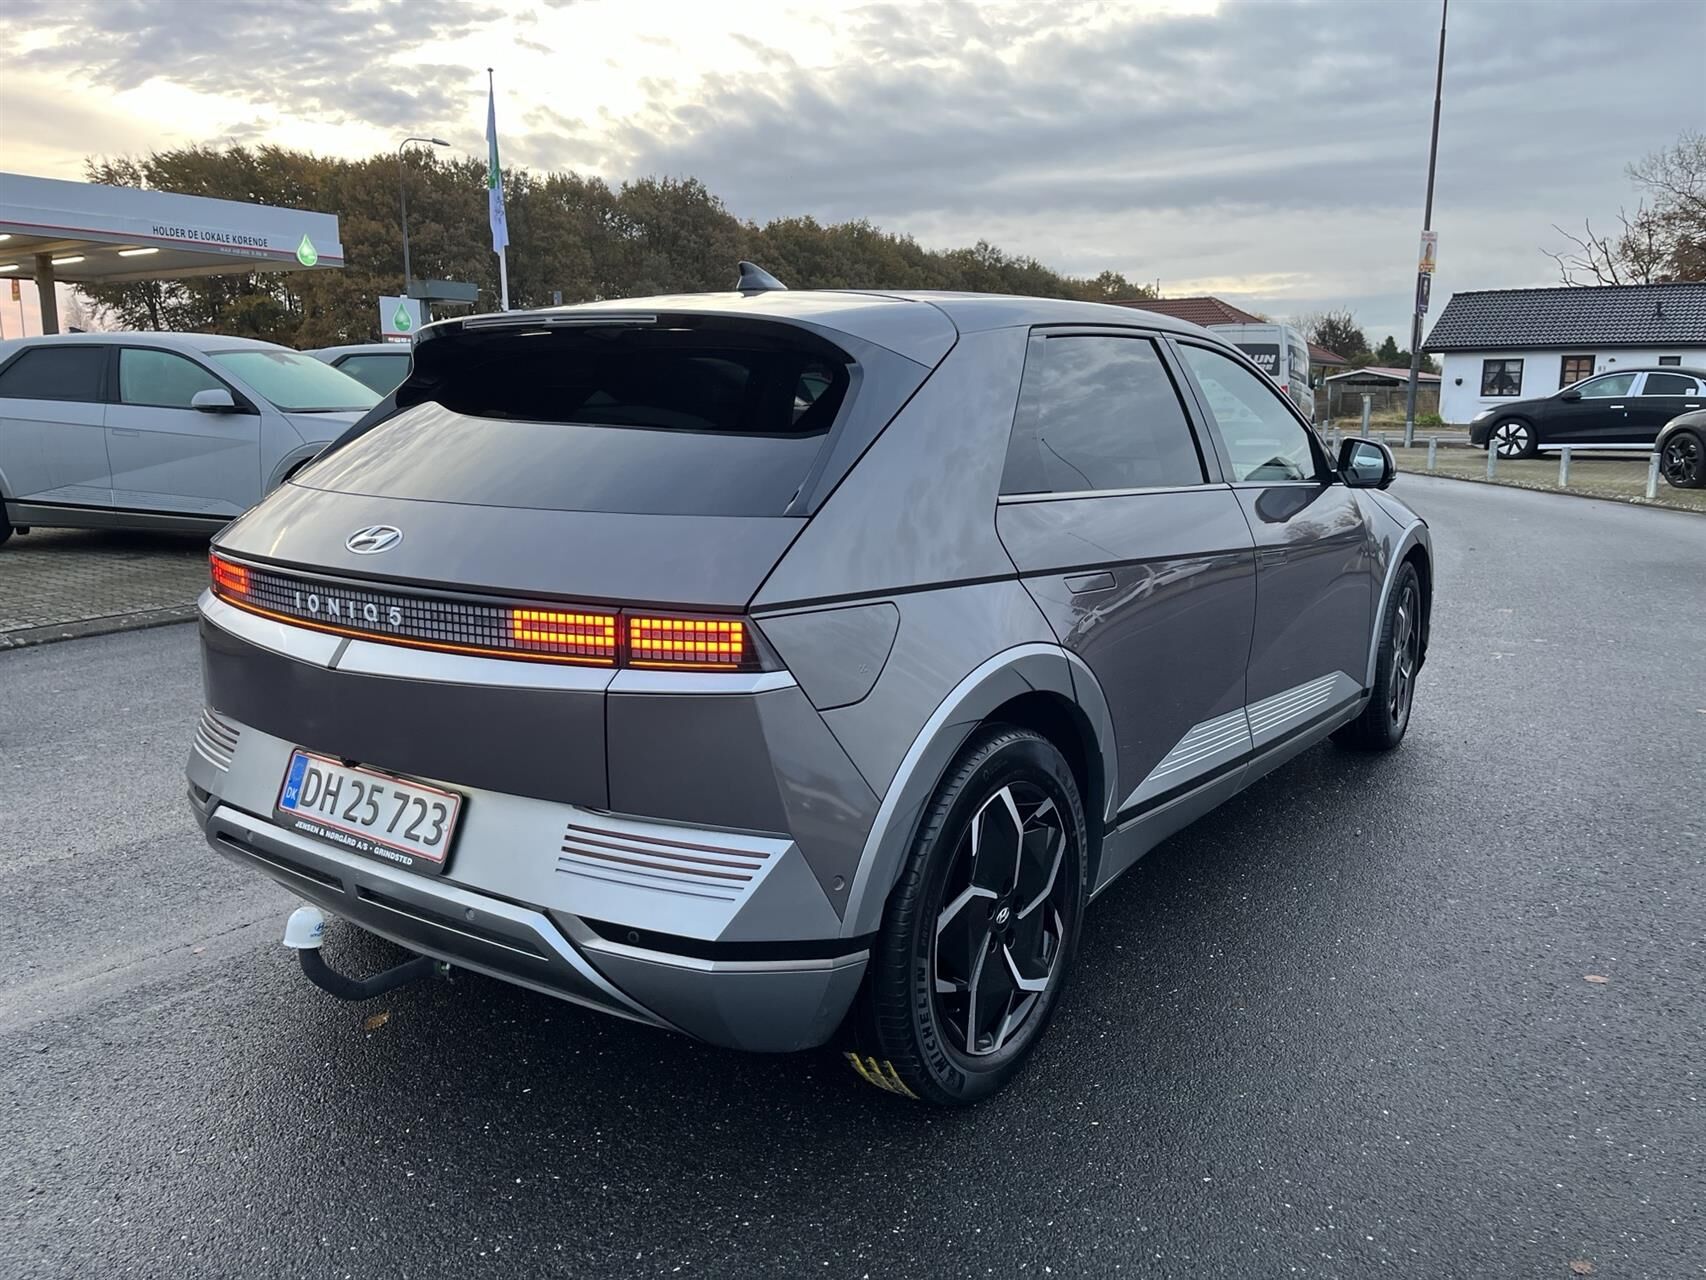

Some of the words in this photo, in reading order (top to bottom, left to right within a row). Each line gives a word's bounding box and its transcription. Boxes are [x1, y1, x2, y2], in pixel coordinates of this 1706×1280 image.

[152, 225, 187, 238] HOLDER
[187, 229, 199, 240] DE
[200, 231, 231, 244] LOKALE
[232, 234, 268, 248] KØRENDE
[295, 591, 378, 623] IONIQ
[389, 606, 402, 626] 5
[285, 785, 299, 801] DK
[300, 767, 344, 815] DH
[342, 780, 385, 826] 25
[386, 791, 448, 846] 723
[294, 820, 319, 835] JENSEN
[319, 828, 325, 836] &
[325, 829, 357, 847] NØRGÅRD
[356, 841, 369, 851] A/S
[373, 846, 413, 866] GRINDSTED
[917, 966, 948, 1075] MICHELIN
